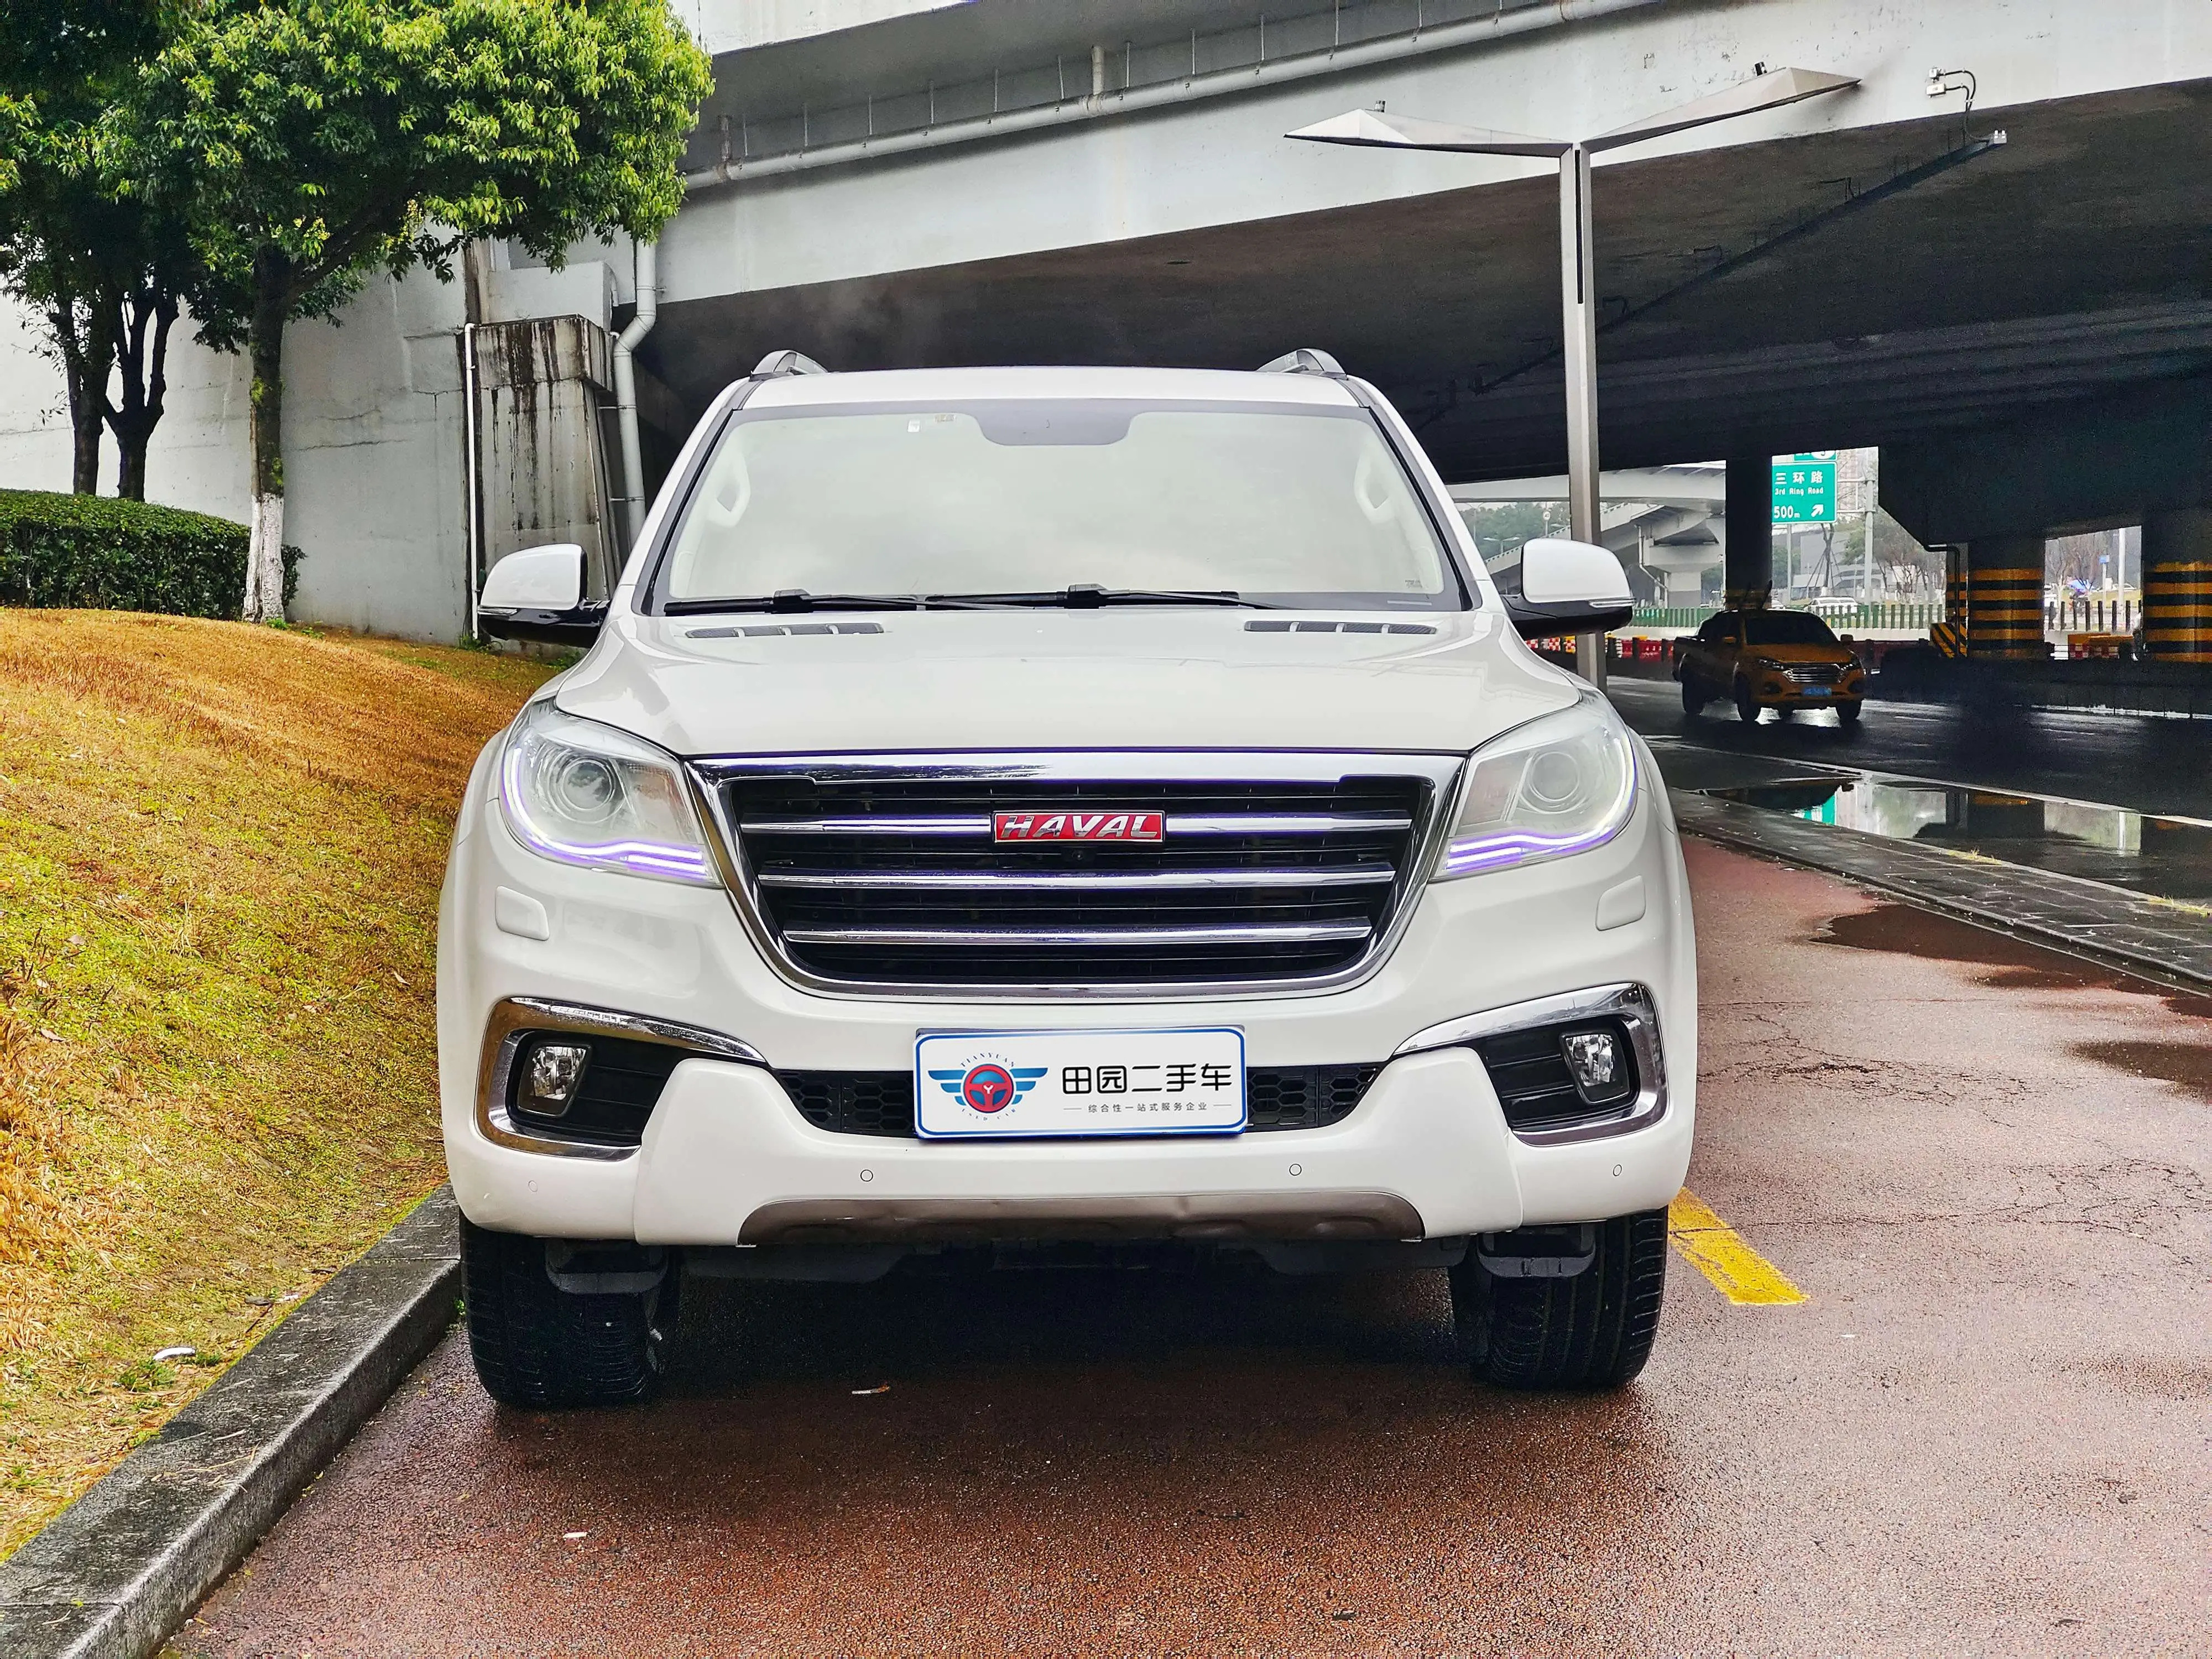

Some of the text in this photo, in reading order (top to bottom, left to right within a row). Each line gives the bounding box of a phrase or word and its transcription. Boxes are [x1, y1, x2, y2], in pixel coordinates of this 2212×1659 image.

[1774, 470, 1823, 484] 三环路
[1789, 487, 1804, 496] Ring
[1000, 815, 1157, 838] HAVAL
[1062, 1063, 1232, 1094] 田园二手车
[1087, 1102, 1208, 1113] 综合性一站式服务企业
